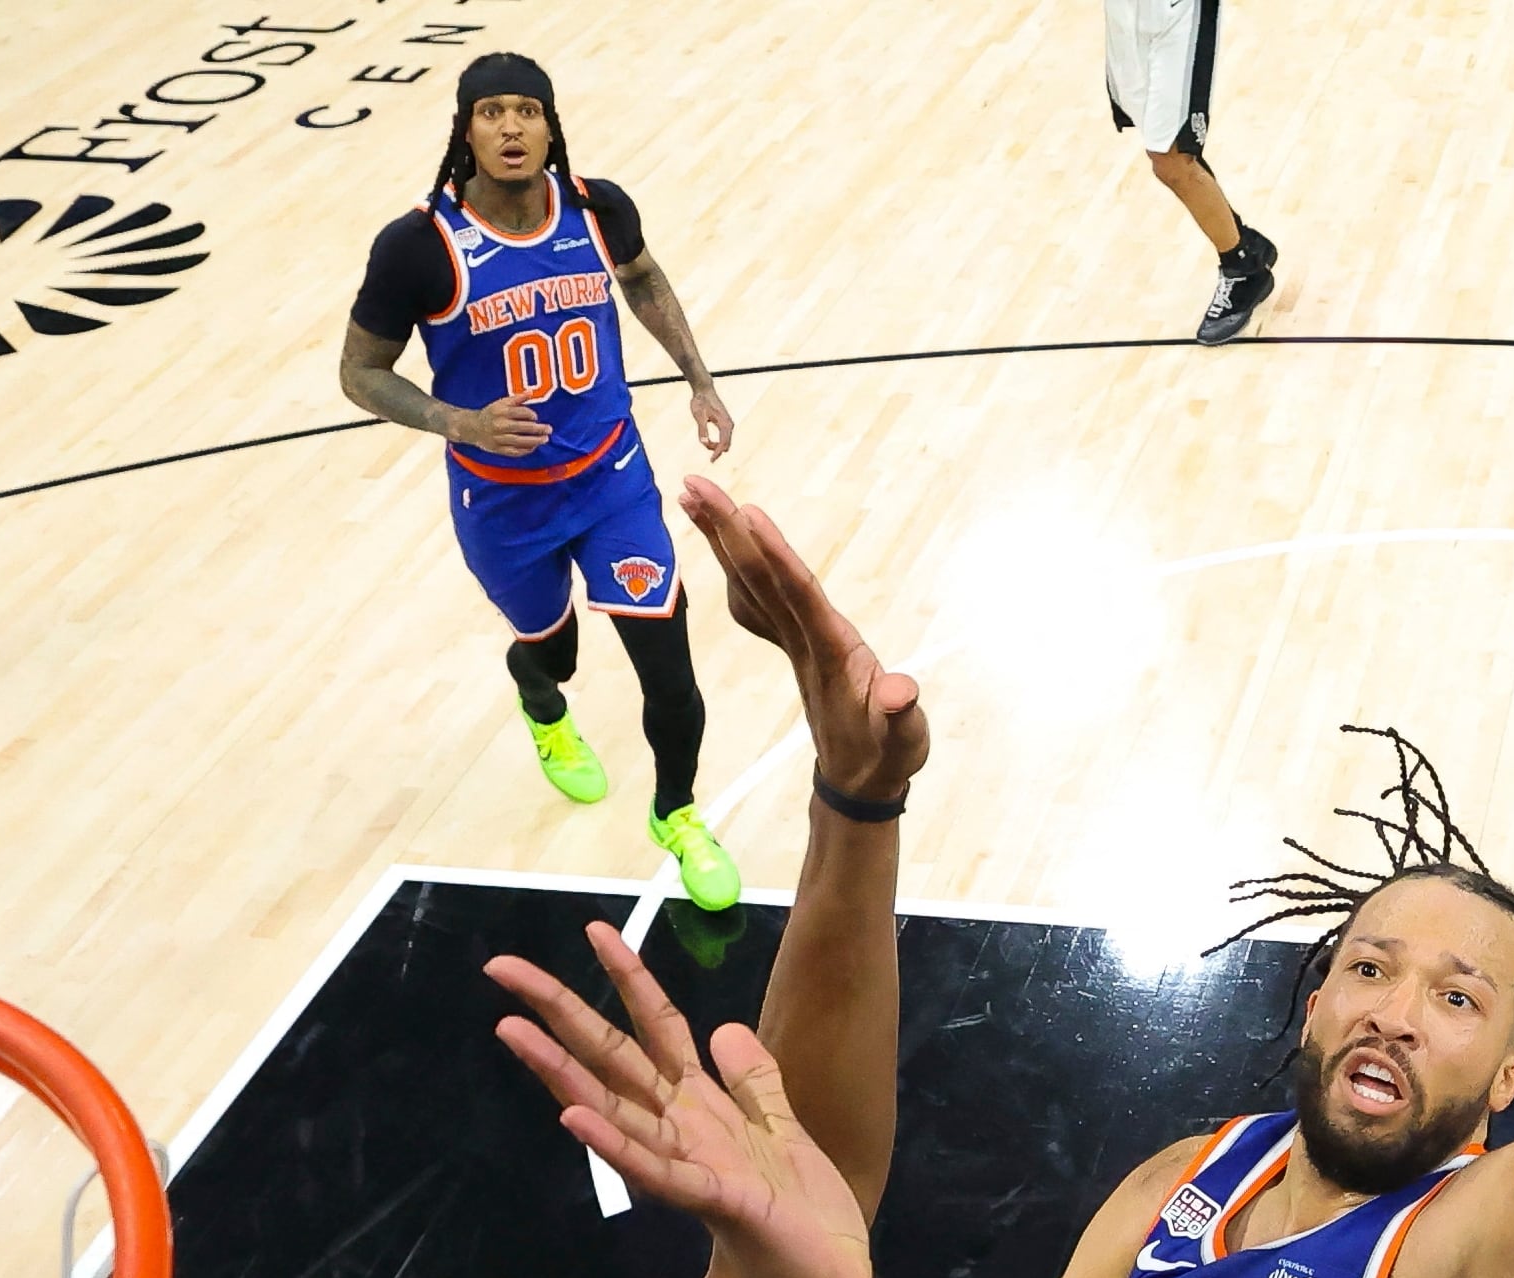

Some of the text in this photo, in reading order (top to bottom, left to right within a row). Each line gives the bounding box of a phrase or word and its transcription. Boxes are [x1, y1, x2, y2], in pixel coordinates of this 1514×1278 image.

[466, 271, 609, 336] NEW YORK
[503, 316, 600, 405] 00
[1164, 1204, 1203, 1235] 250
[1179, 1189, 1213, 1220] USA
